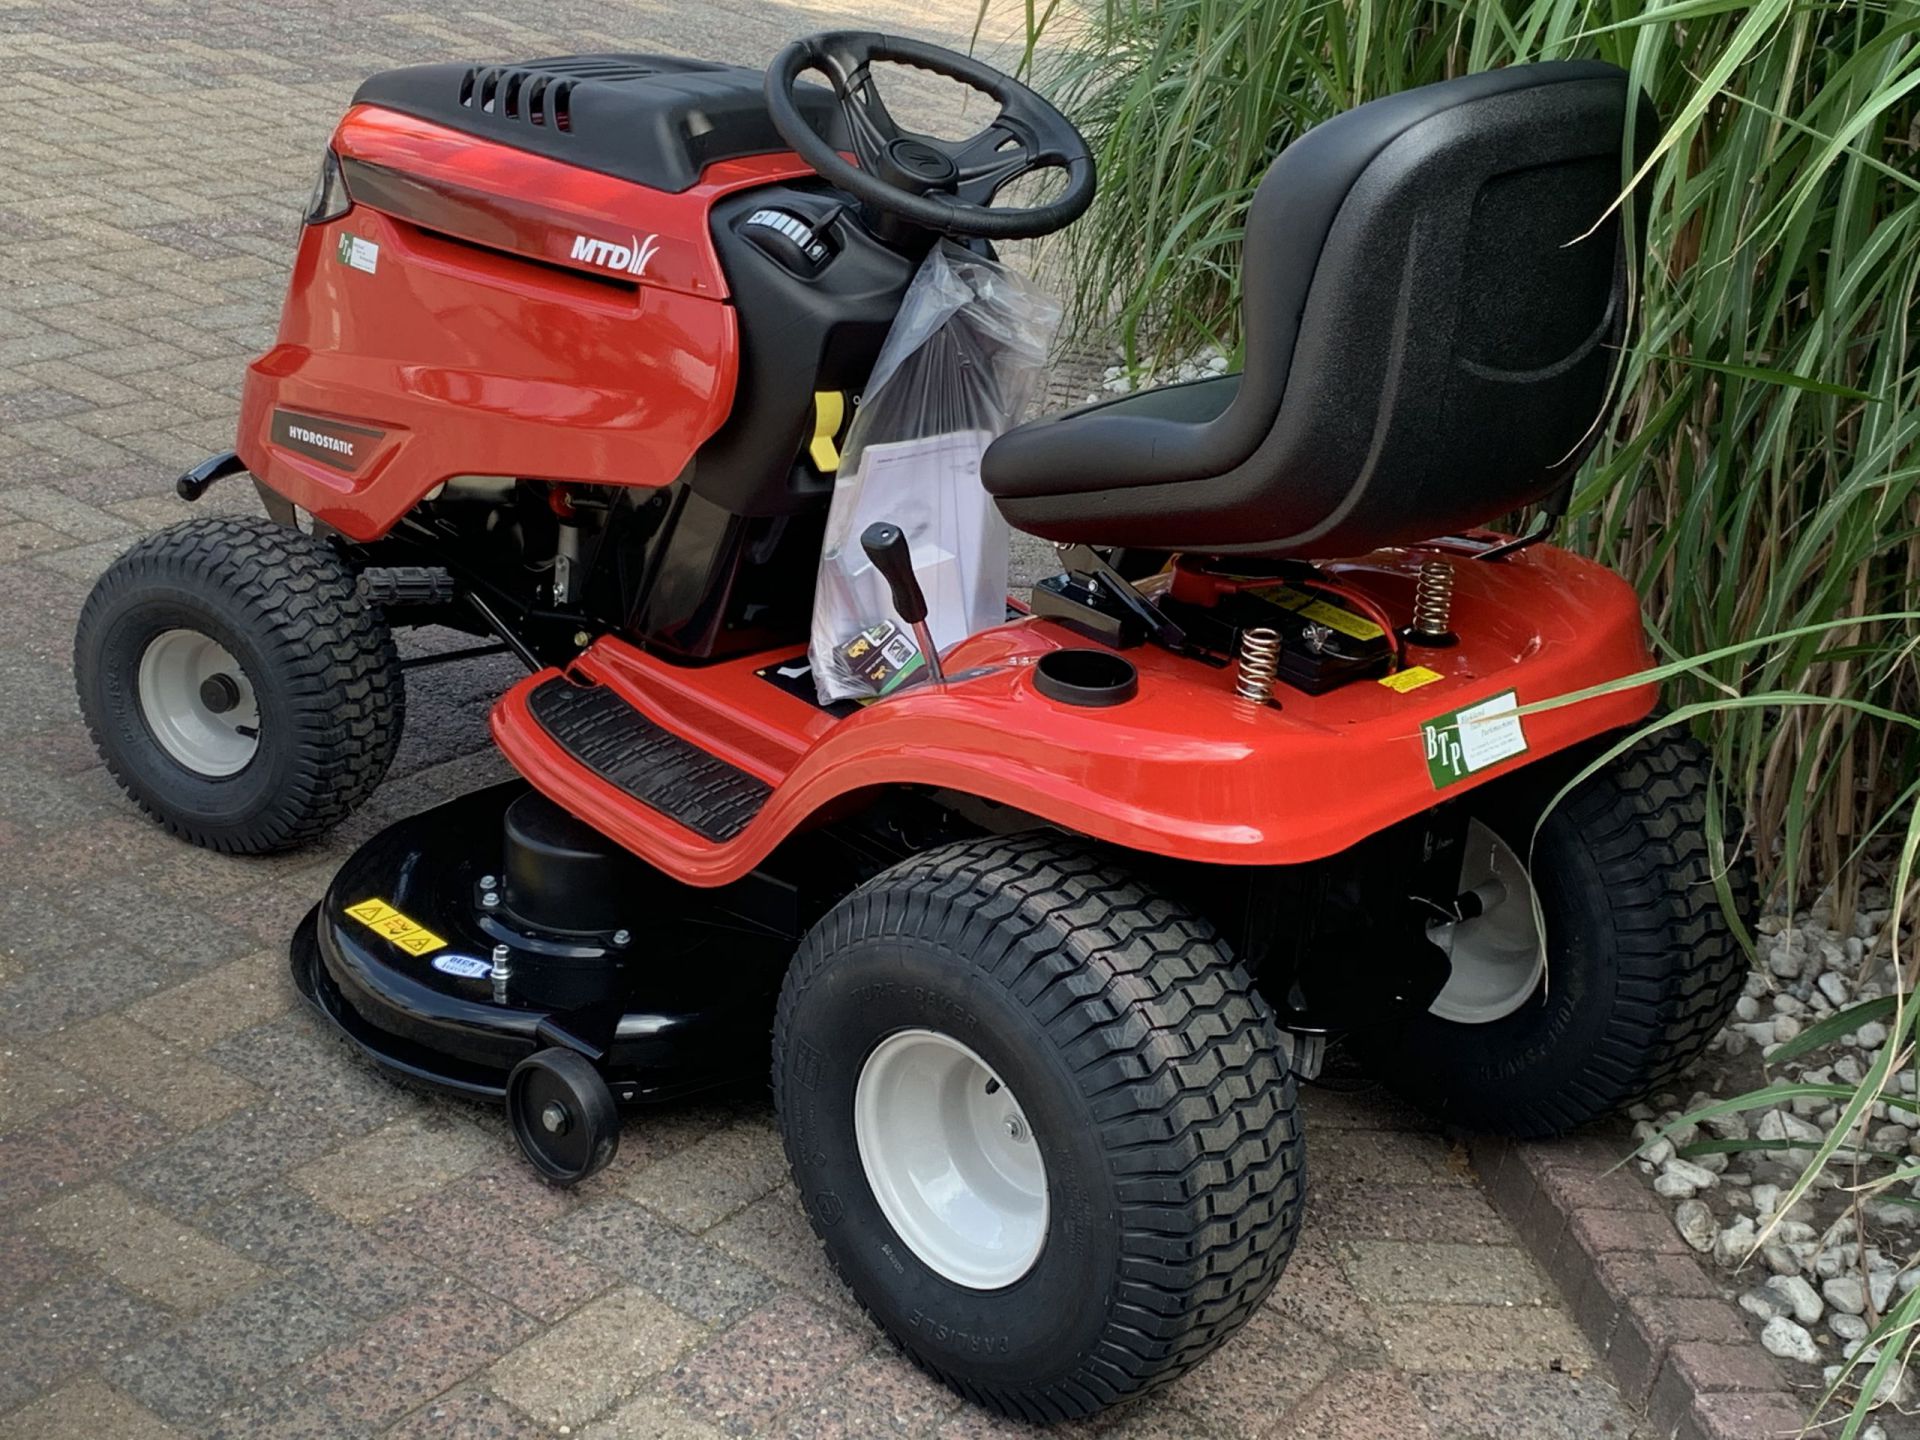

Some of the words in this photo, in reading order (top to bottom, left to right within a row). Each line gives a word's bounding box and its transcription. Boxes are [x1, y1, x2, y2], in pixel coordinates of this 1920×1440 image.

[570, 235, 631, 270] MTD
[289, 425, 354, 456] HYDROSTATIC
[1425, 725, 1462, 776] BTP
[908, 1307, 1010, 1354] CARLISLE
